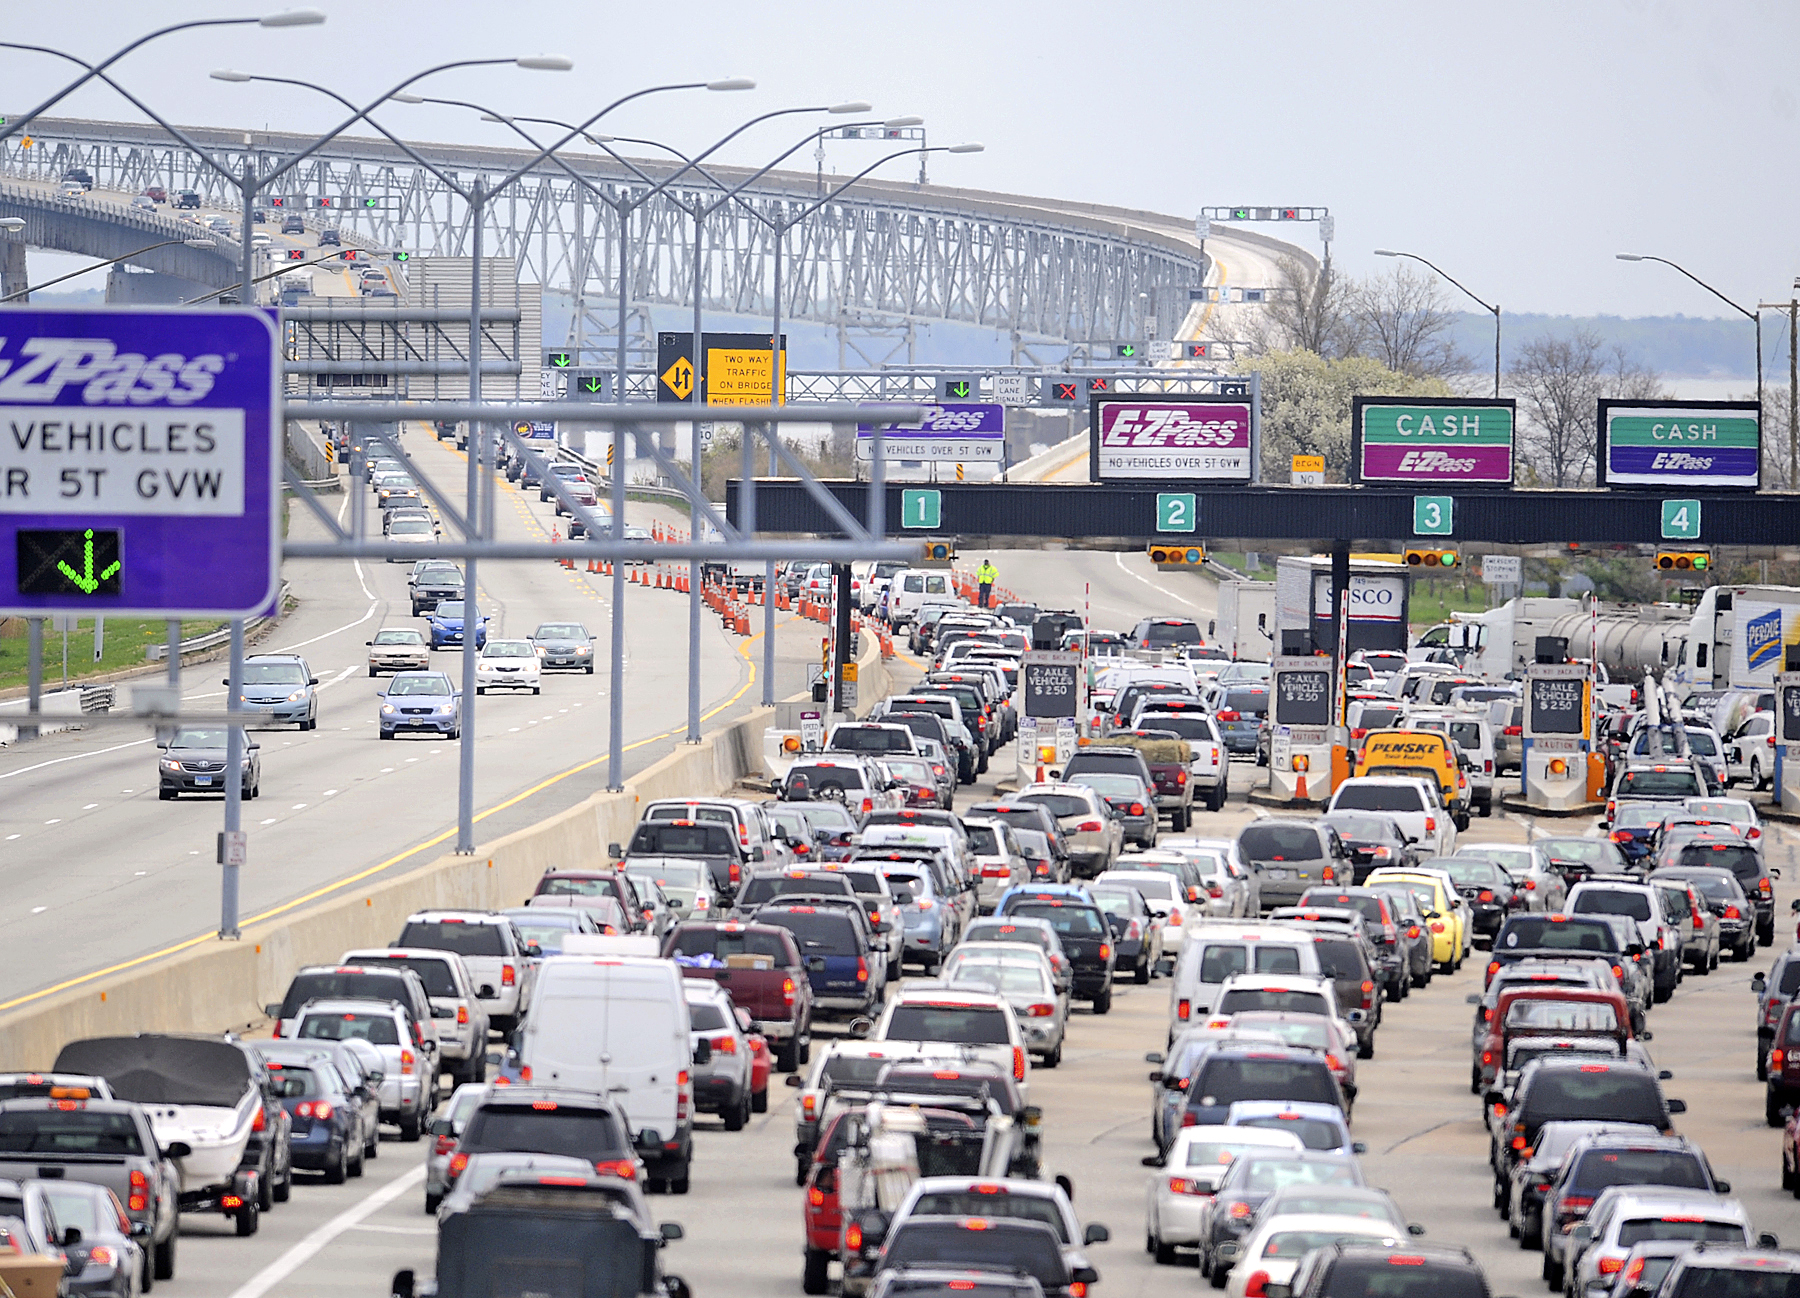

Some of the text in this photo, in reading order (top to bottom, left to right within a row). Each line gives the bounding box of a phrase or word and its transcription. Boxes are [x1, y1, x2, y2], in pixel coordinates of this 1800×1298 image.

[724, 355, 743, 363] TWO
[726, 368, 767, 377] TRAFFIC
[719, 381, 772, 390] ON BRIDGE
[711, 397, 735, 406] WHEN
[1103, 409, 1239, 446] E-ZPass
[1396, 414, 1480, 436] CASH
[10, 421, 217, 452] VEHICLES
[1652, 424, 1717, 440] CASH
[886, 445, 926, 455] VEHICLES
[931, 446, 953, 455] OVER
[959, 446, 969, 455] 5T
[975, 446, 993, 455] GVW
[1109, 458, 1241, 468] NO VEHICLES OVER 5T GVW
[1397, 451, 1477, 472] E-ZPass
[1651, 452, 1713, 470] E-ZPass
[60, 468, 107, 498] 5T
[136, 468, 223, 499] GVW
[1300, 475, 1314, 484] NO
[917, 496, 926, 521] 1
[1168, 500, 1185, 525] 2
[1424, 502, 1441, 528] 3
[1671, 507, 1689, 531] 4
[1326, 587, 1392, 604] SSCO
[1749, 618, 1780, 648] PERDUE
[1033, 667, 1069, 676] 2-AXLE
[1029, 676, 1074, 685] VEHICLES
[1284, 674, 1320, 683] 2-AXLE
[1035, 686, 1043, 695] $
[1281, 683, 1325, 693] VEHICLES
[1539, 683, 1574, 692] 2-AXLE
[1286, 692, 1294, 702] $
[1535, 692, 1578, 701] VEHICLES
[1540, 701, 1548, 711] $
[1292, 733, 1320, 741] AUTION
[1371, 743, 1440, 753] PENSKE
[1538, 740, 1573, 749] CAUTION
[1275, 757, 1284, 766] 10
